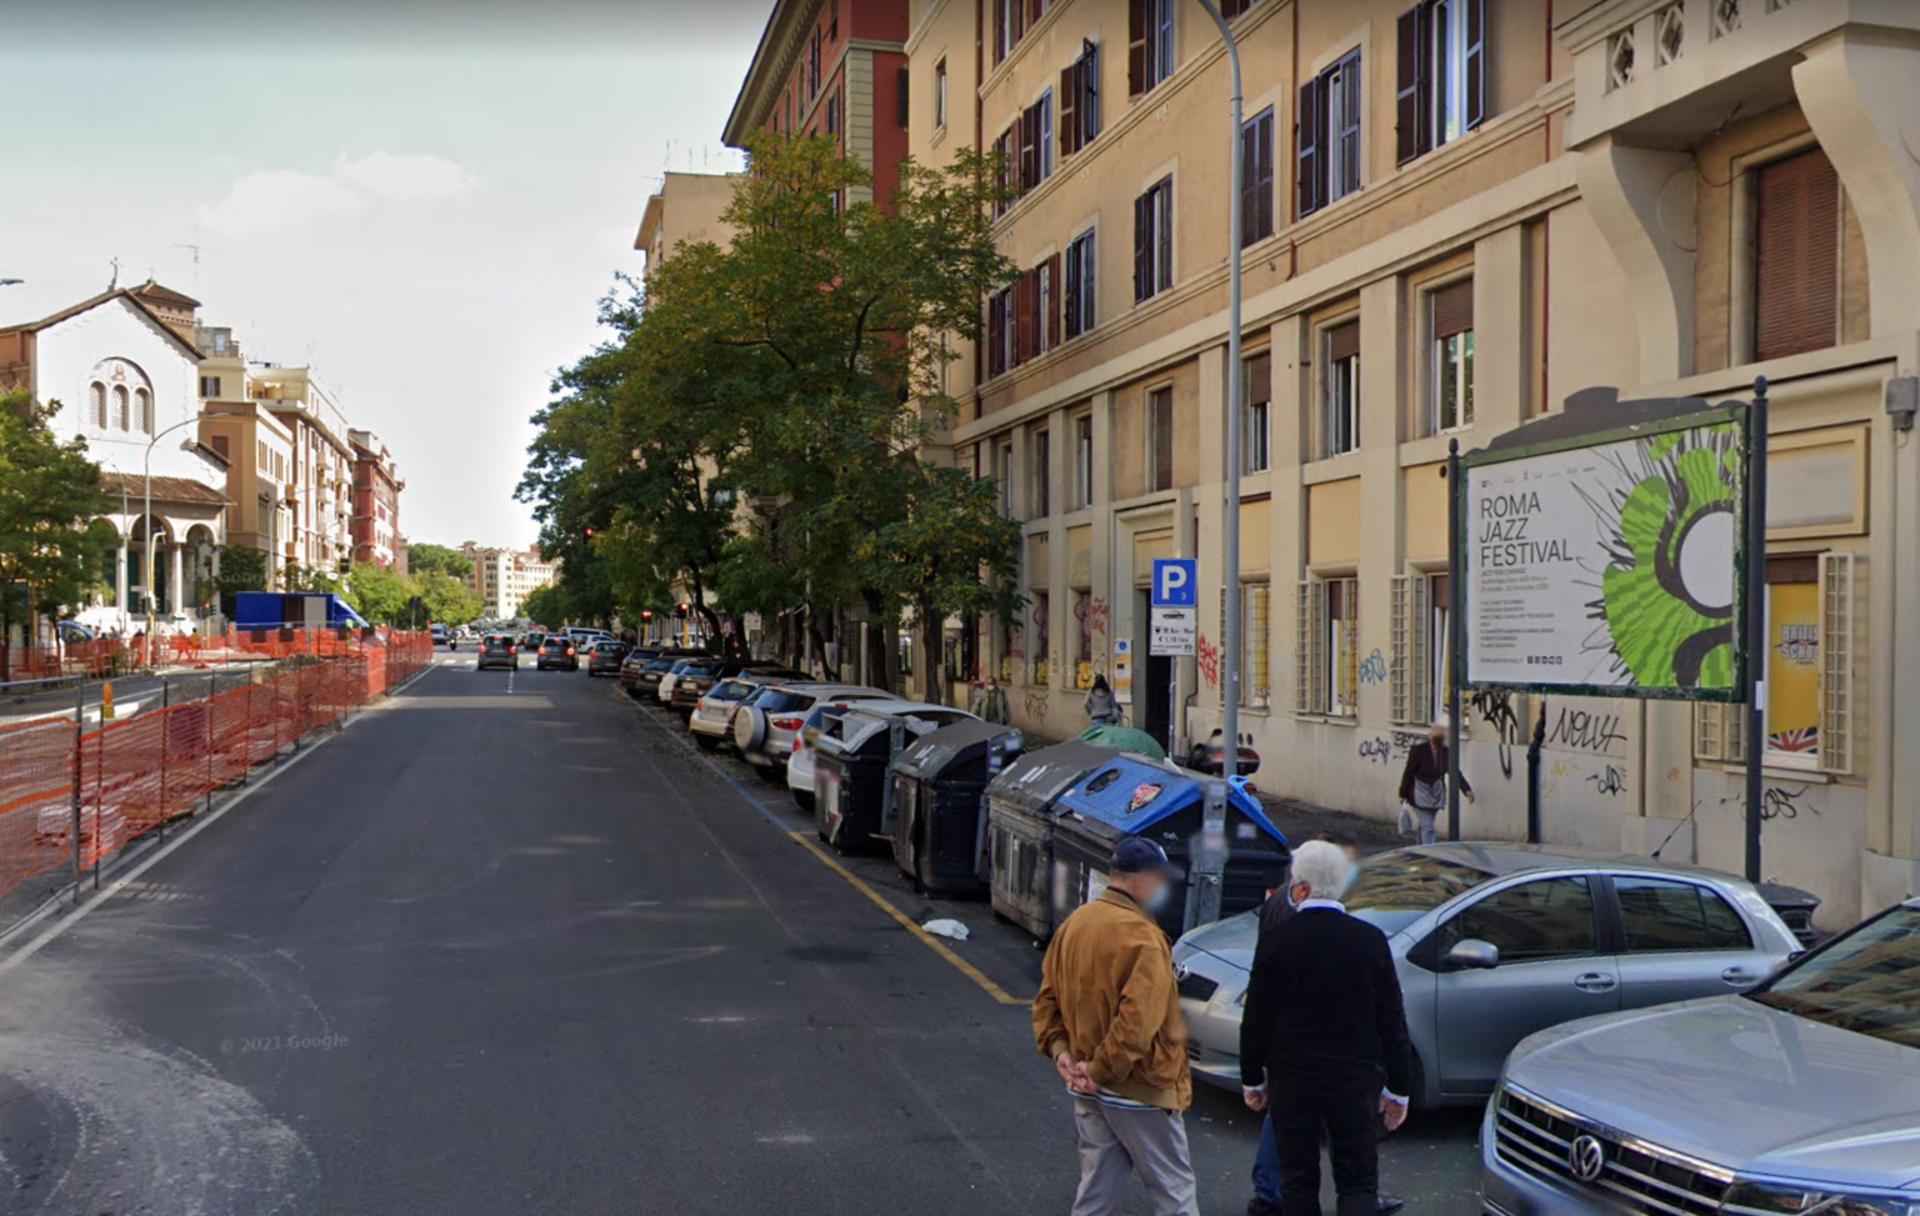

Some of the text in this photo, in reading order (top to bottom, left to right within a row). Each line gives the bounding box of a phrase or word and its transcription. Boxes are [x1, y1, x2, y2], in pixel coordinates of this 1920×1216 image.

[1481, 491, 1541, 519] ROMA
[1480, 517, 1528, 544] JAZZ
[1481, 539, 1573, 567] FESTIVAL
[1162, 565, 1187, 600] P
